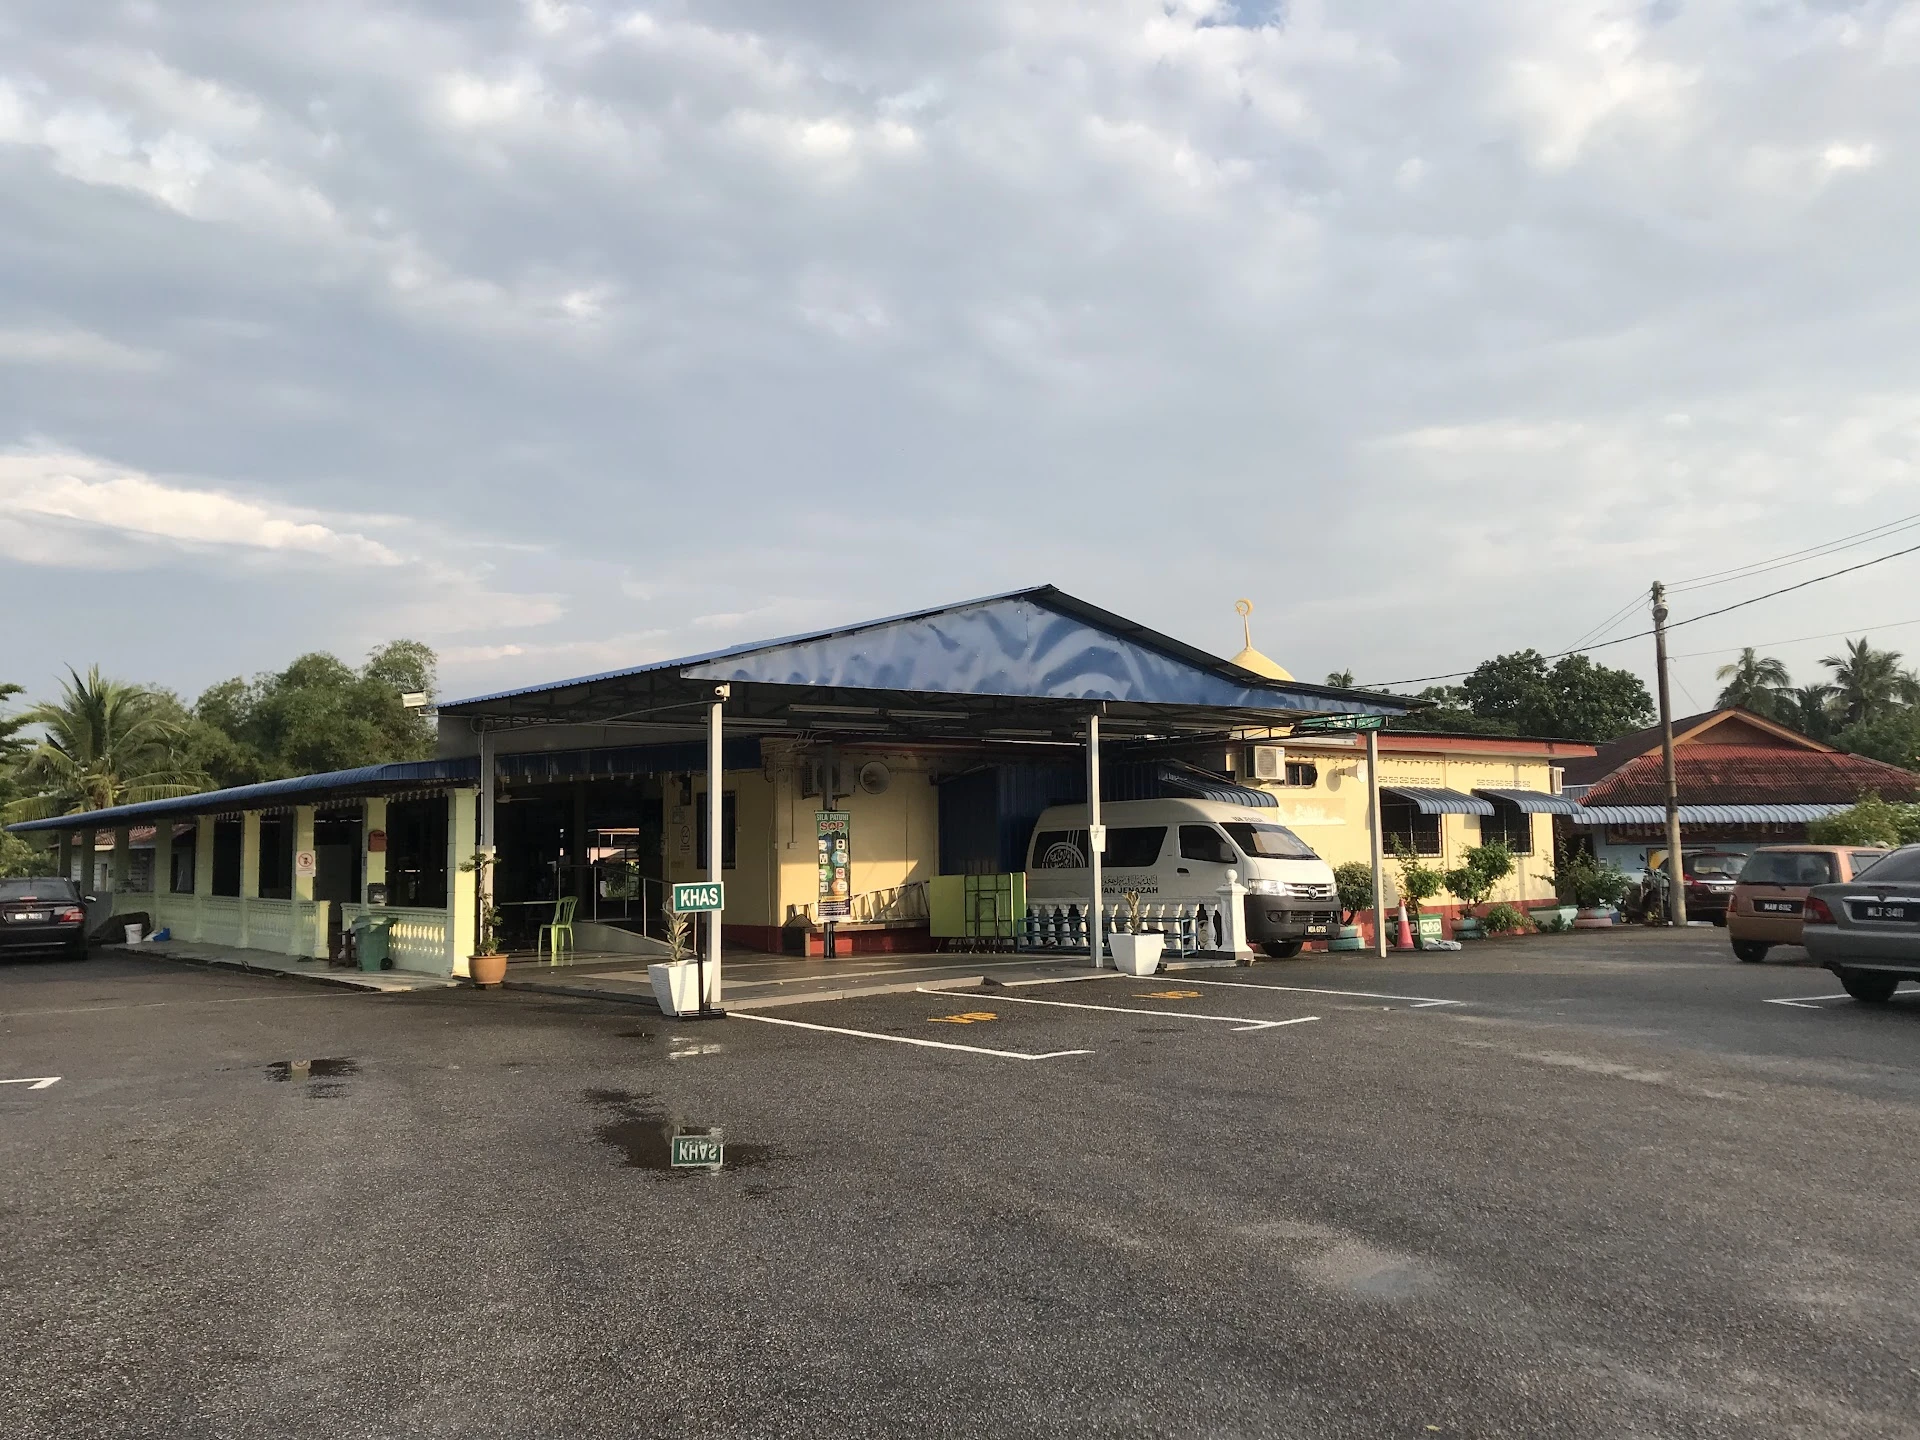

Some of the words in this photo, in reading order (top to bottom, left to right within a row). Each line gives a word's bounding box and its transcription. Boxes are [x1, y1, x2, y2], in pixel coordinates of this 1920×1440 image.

[820, 820, 845, 832] SOP
[680, 887, 719, 907] KHAS
[1867, 906, 1884, 917] WLT
